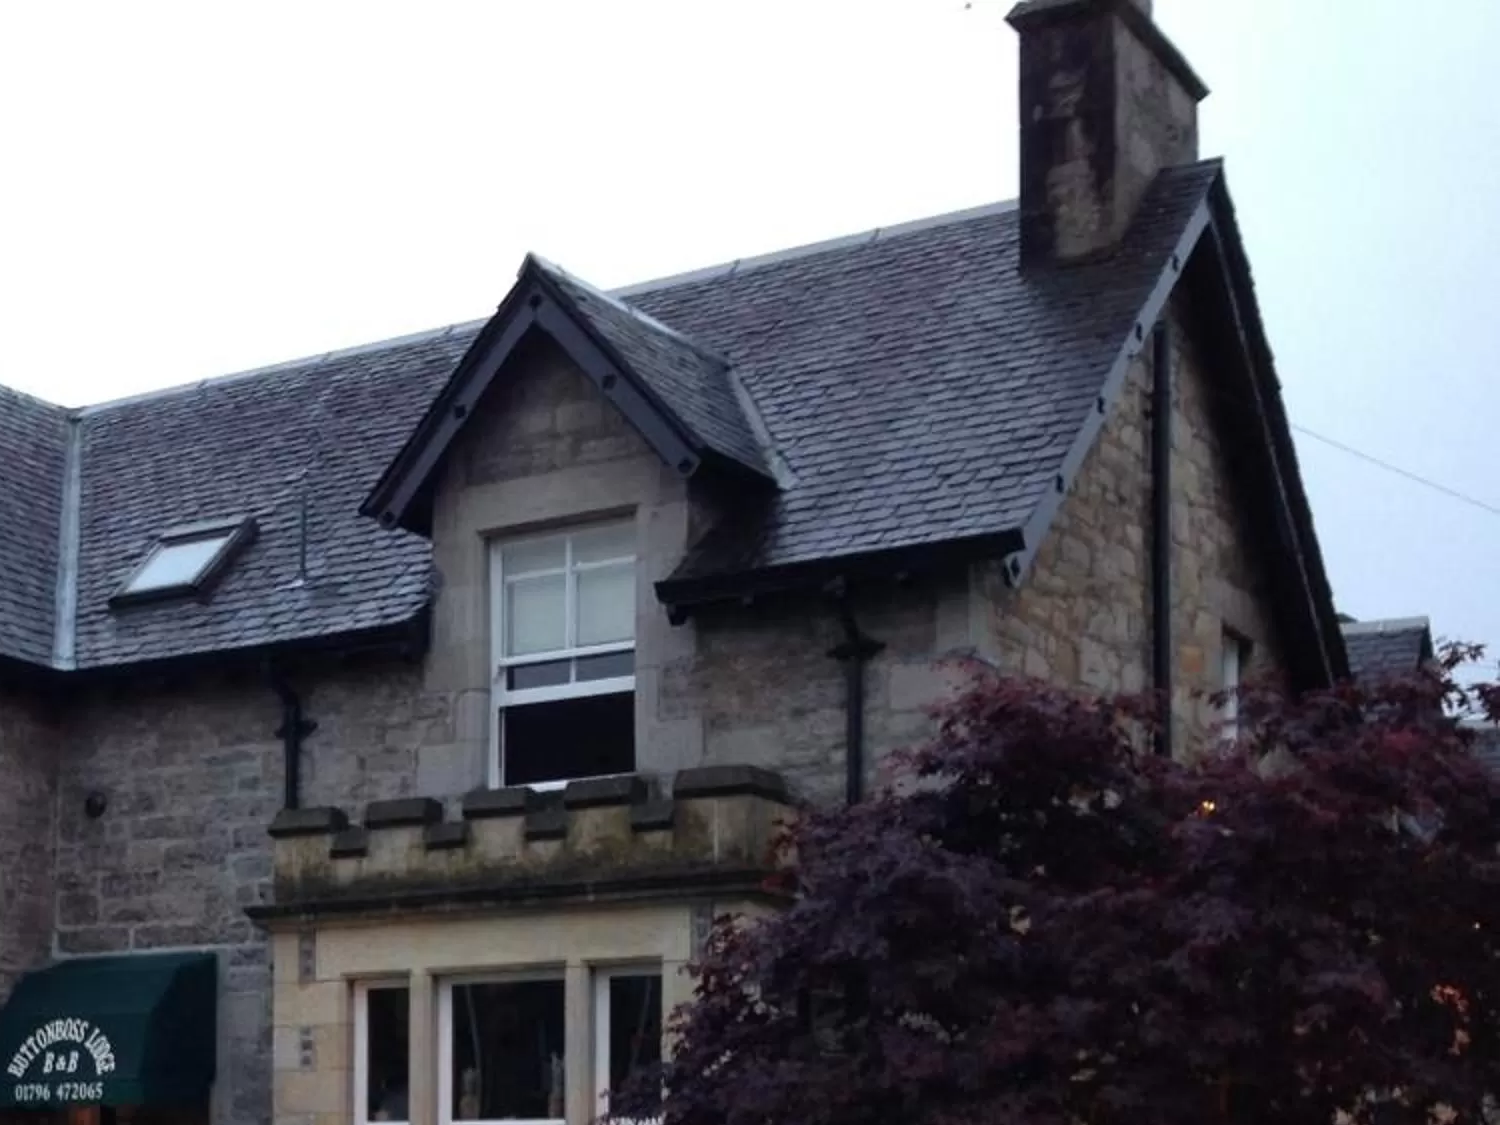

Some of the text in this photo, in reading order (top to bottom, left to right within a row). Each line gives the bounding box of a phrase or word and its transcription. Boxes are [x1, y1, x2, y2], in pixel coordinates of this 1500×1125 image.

[7, 1017, 115, 1079] BUTTONBOSS LODGE
[43, 1050, 79, 1074] B & B
[15, 1081, 104, 1101] 01796 472065
